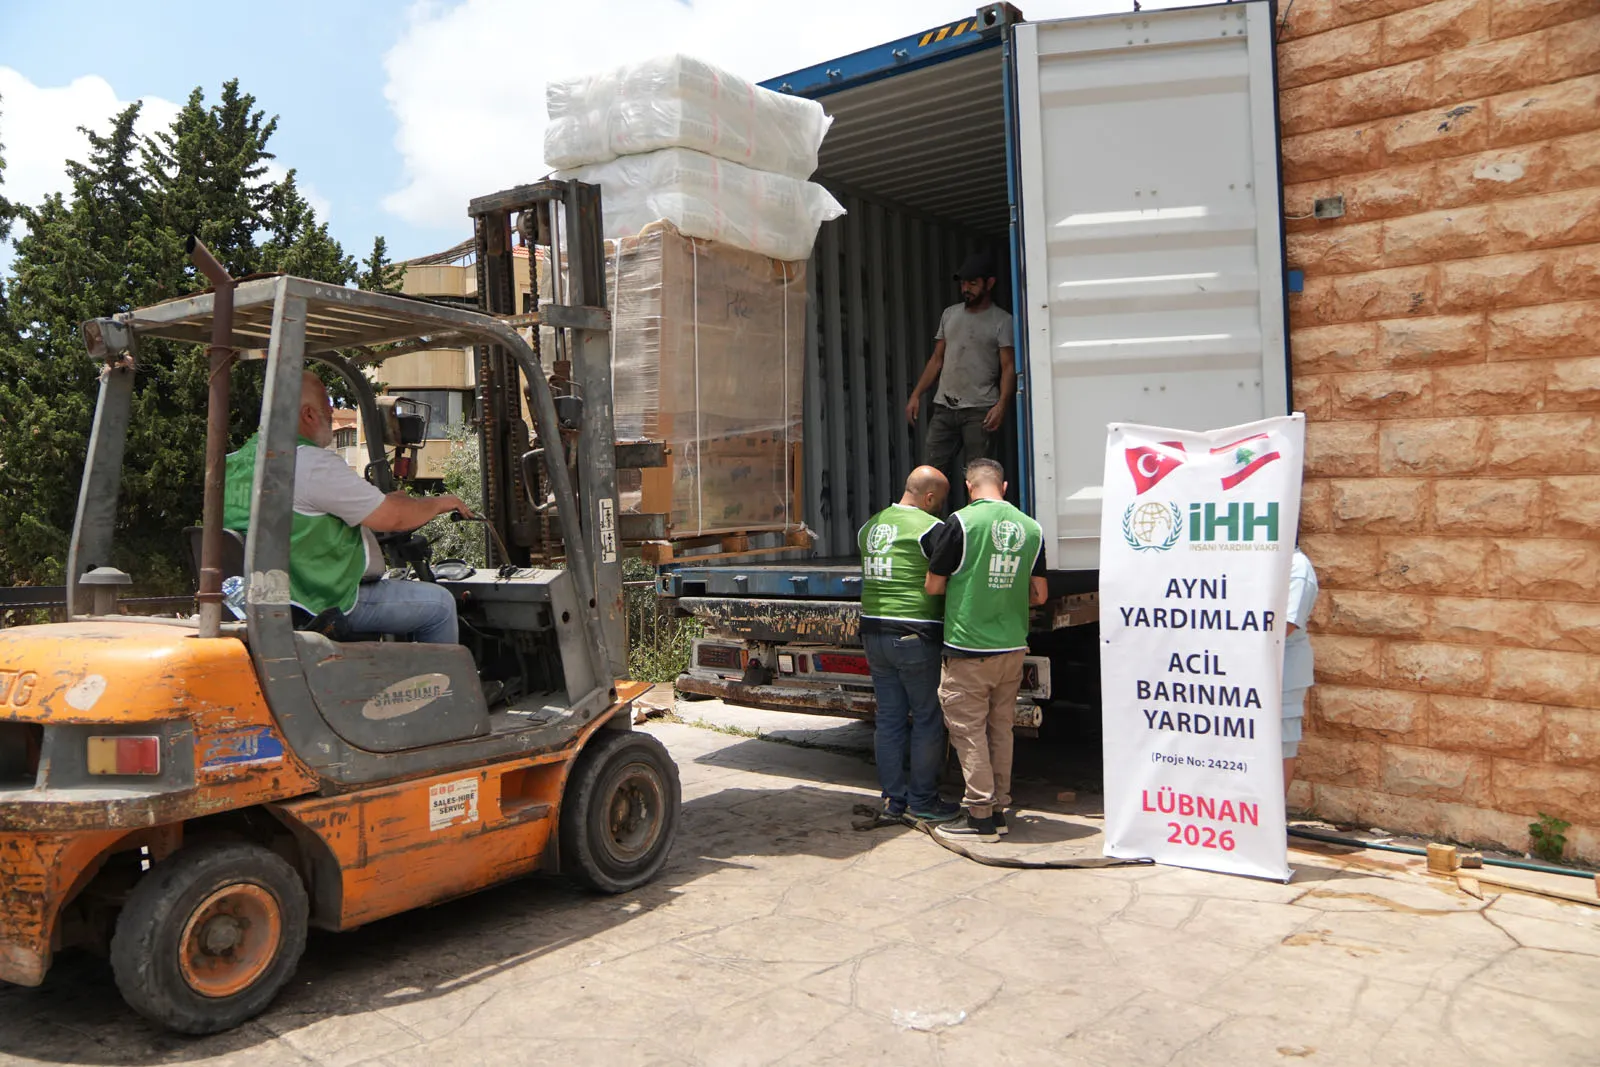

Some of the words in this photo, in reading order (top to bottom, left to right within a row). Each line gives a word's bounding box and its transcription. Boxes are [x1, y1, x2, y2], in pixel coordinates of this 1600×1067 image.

[1165, 574, 1227, 600] AYNİ
[1120, 607, 1275, 632] YARDIMLAR
[1168, 649, 1226, 676] ACİL
[1136, 680, 1262, 709] BARINMA
[1144, 709, 1255, 739] YARDIMI
[1151, 752, 1184, 765] (Proje
[1186, 755, 1205, 768] No:
[1208, 759, 1248, 773] 24224)
[1142, 785, 1259, 826] LÜBNAN
[1167, 822, 1236, 852] 2026
